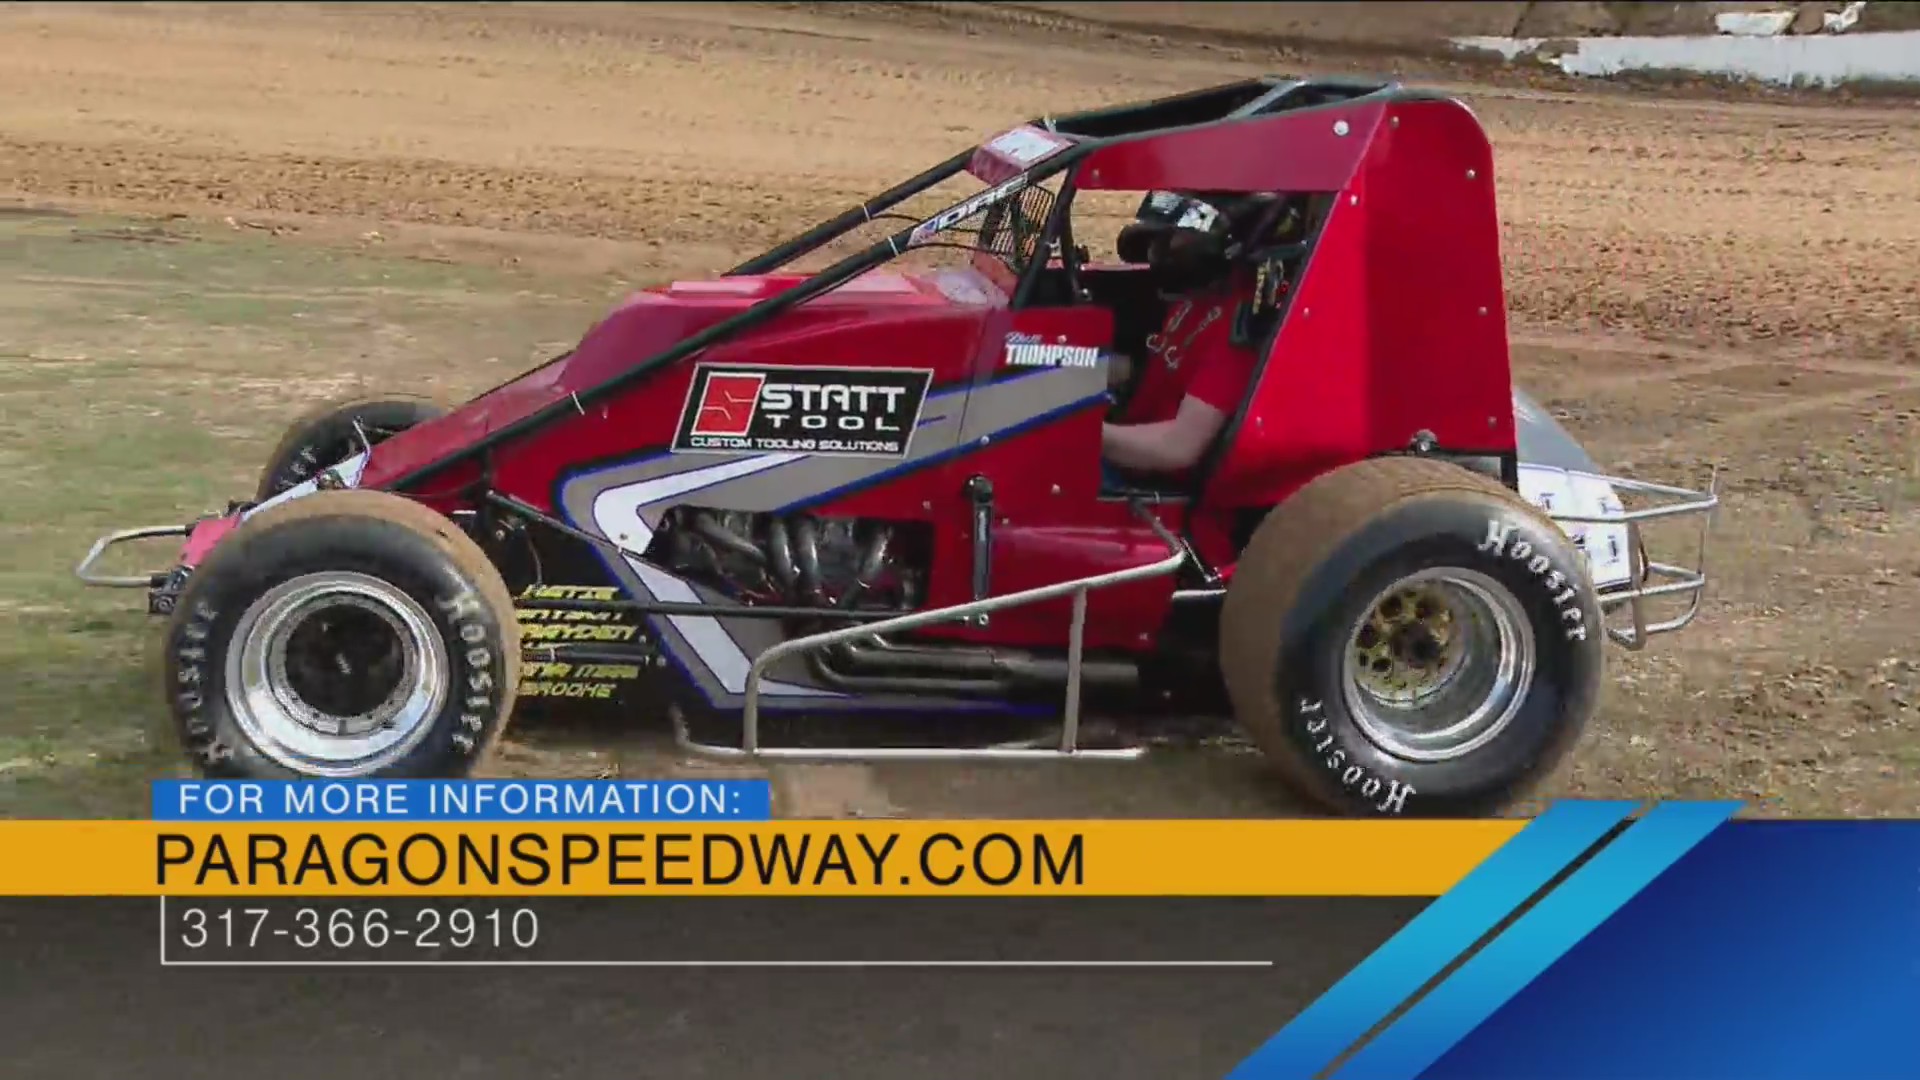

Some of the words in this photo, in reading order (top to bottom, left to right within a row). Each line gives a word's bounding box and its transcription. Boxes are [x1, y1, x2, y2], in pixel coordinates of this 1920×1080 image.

[1005, 343, 1099, 368] THOMPSON
[761, 383, 906, 412] STATT
[765, 413, 901, 431] TOOL
[690, 436, 752, 449] CUSTOM
[756, 438, 816, 450] TOOLING
[818, 439, 900, 452] SOLUTIONS
[1477, 519, 1588, 642] Hoosier
[1300, 697, 1418, 814] Hoosier
